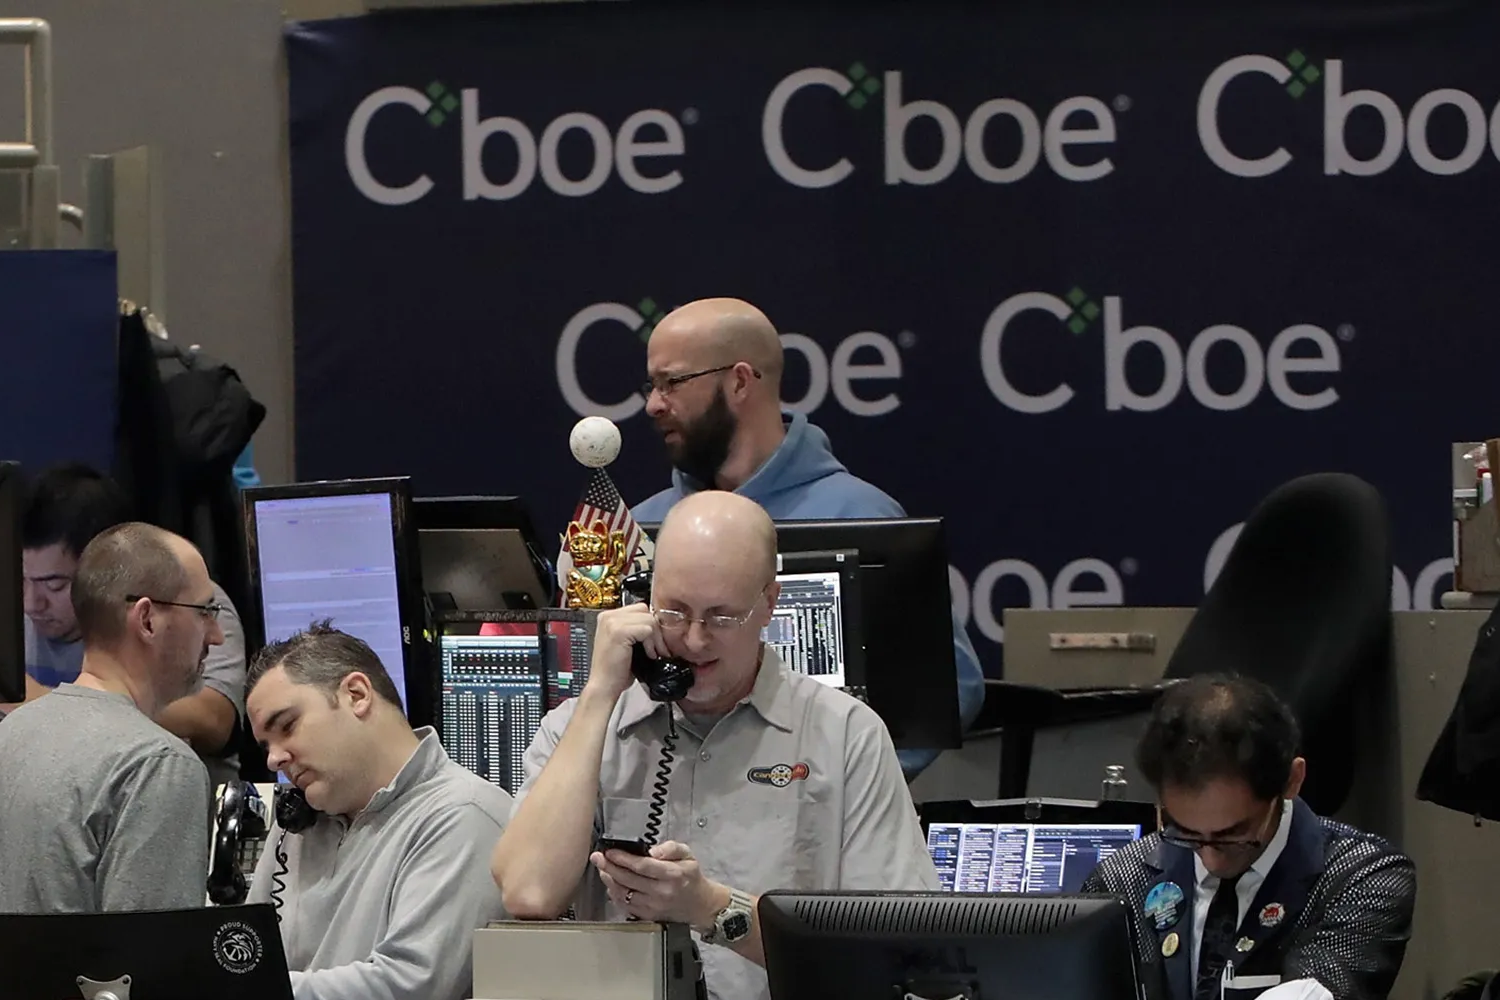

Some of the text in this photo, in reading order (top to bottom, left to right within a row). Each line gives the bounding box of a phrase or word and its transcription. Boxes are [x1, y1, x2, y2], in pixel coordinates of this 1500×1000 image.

[1196, 54, 1500, 177] Cbo
[556, 301, 903, 421] Coe
[947, 557, 1125, 644] oe
